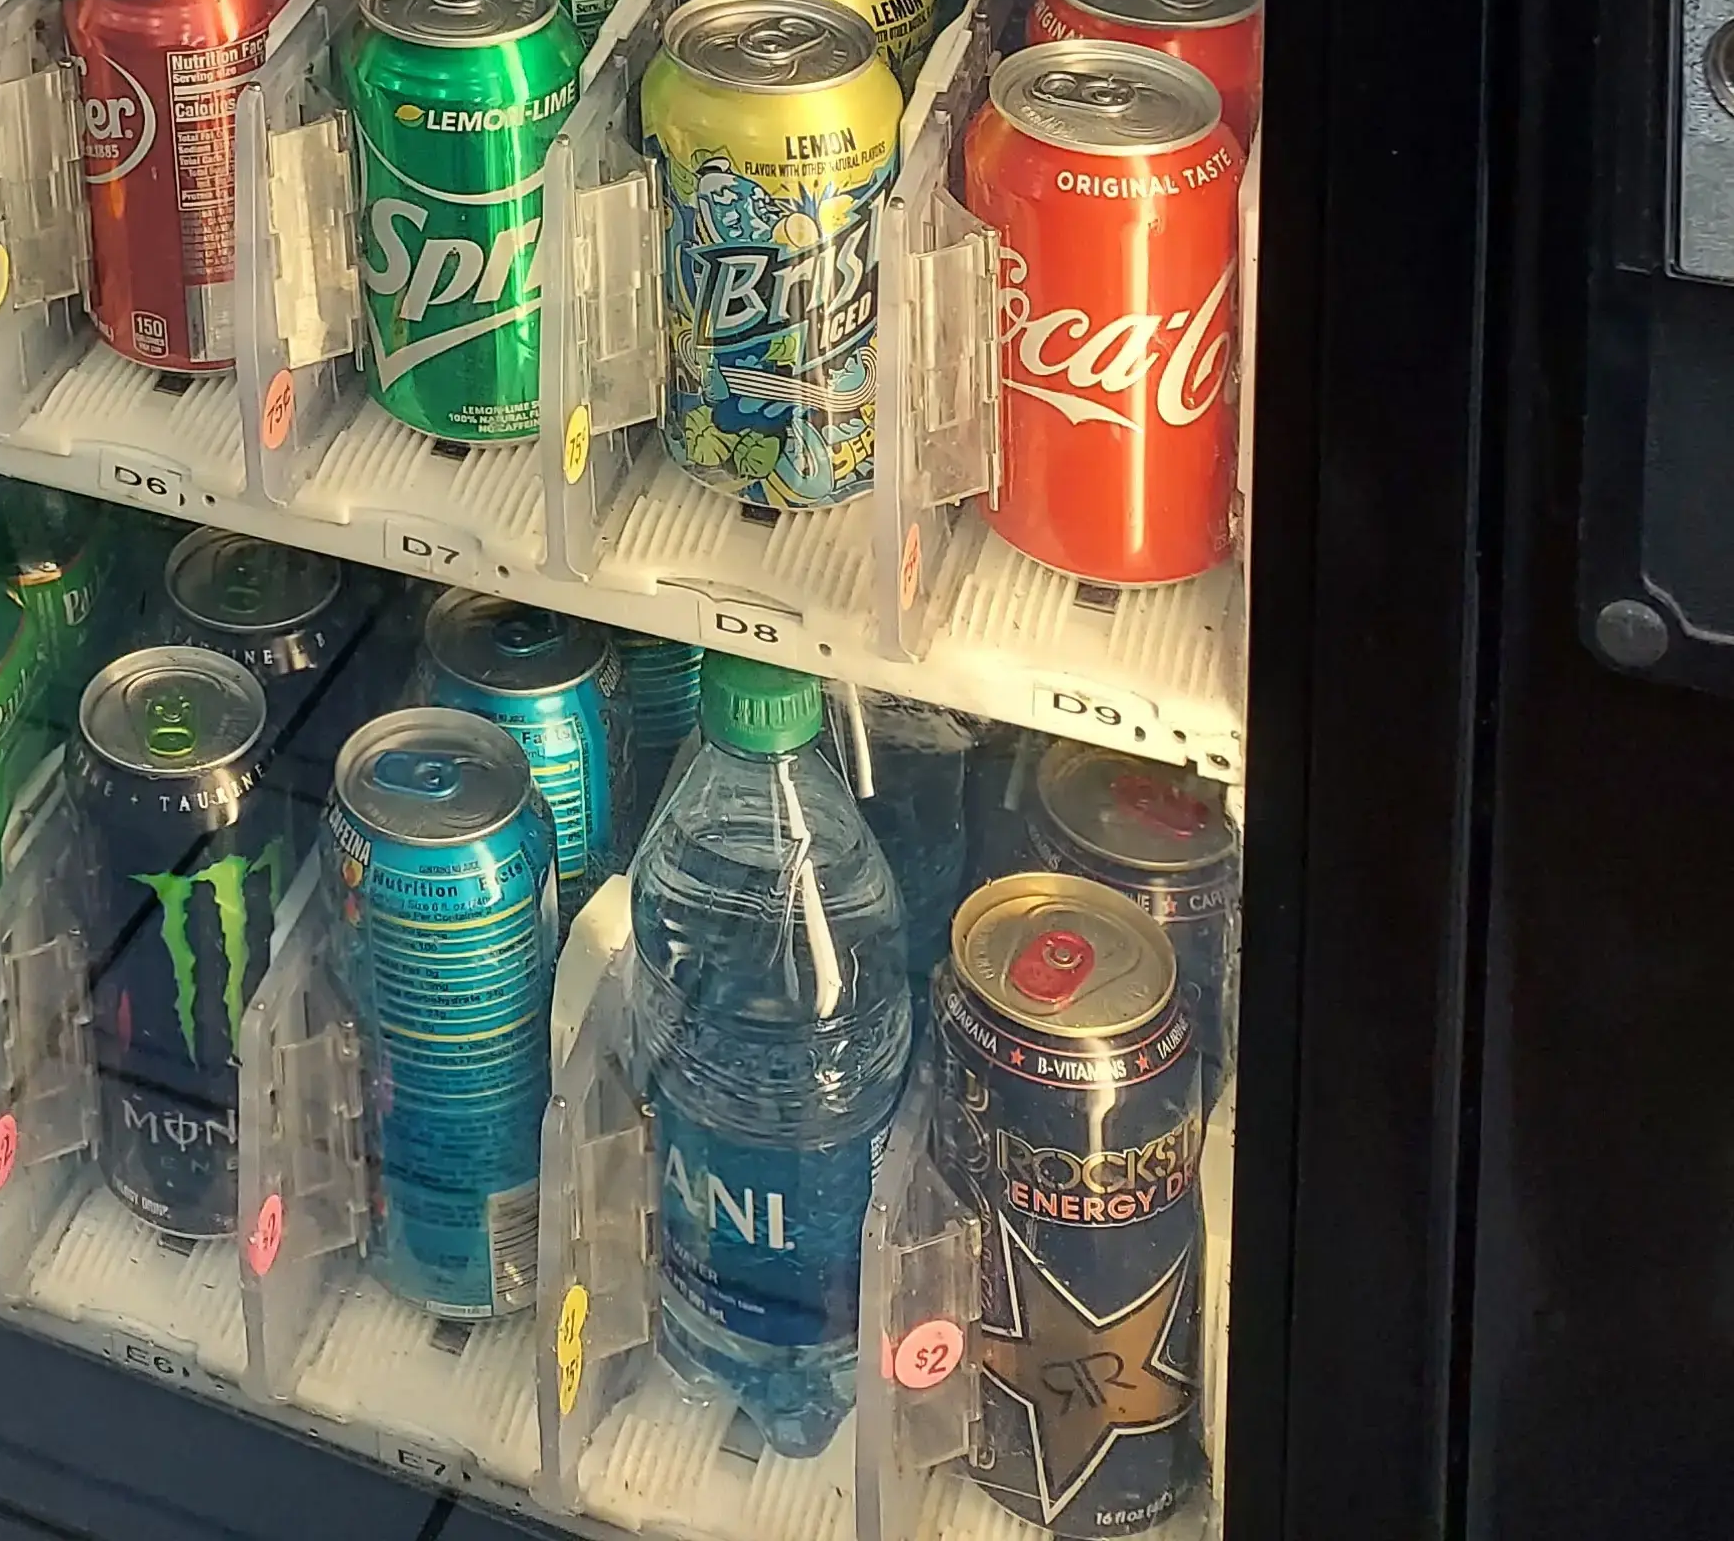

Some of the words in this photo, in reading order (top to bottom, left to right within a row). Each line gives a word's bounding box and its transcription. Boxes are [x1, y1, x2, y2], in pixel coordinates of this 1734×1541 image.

[172, 49, 239, 71] Nutrition
[172, 71, 214, 85] Serving
[426, 79, 578, 133] LEMON-LIME
[785, 127, 857, 161] LEMON
[745, 161, 776, 177] FLAVOR
[779, 161, 800, 177] WITH
[1055, 167, 1179, 201] ORIGINAL
[1181, 148, 1234, 196] TASTE
[136, 316, 162, 337] 150
[113, 464, 167, 495] D6
[402, 536, 461, 564] D7
[714, 615, 779, 643] D8
[1052, 694, 1121, 725] D9
[372, 868, 458, 898] Nutrition
[946, 993, 998, 1055] GUARANA
[1011, 1181, 1156, 1222] ENERGY
[126, 1344, 174, 1374] E6
[914, 1343, 948, 1372] $2
[398, 1448, 447, 1477] E7
